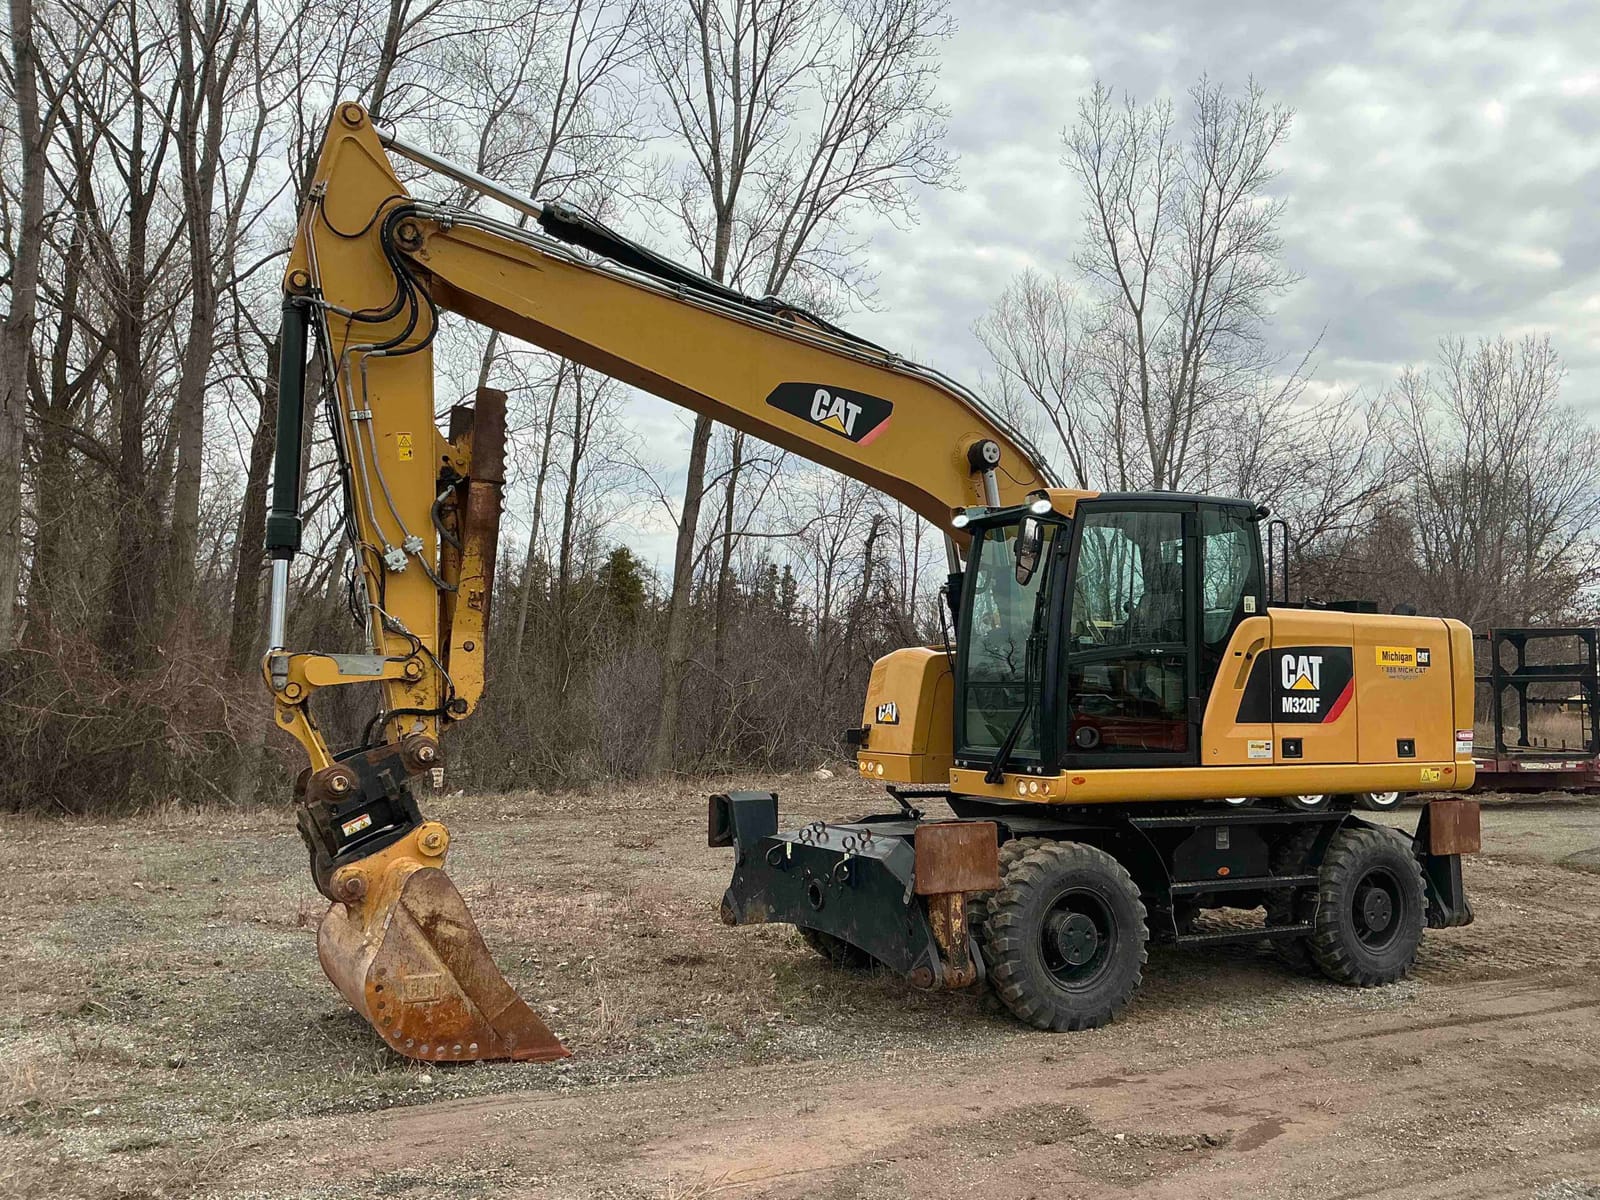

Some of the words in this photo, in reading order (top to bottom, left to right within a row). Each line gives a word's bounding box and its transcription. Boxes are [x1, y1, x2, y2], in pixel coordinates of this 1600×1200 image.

[810, 389, 862, 436] CAT
[1382, 651, 1412, 663] Michigan
[1417, 652, 1428, 662] CAT
[1281, 654, 1323, 690] CAT
[878, 702, 897, 721] CAT
[1282, 697, 1320, 713] M320F
